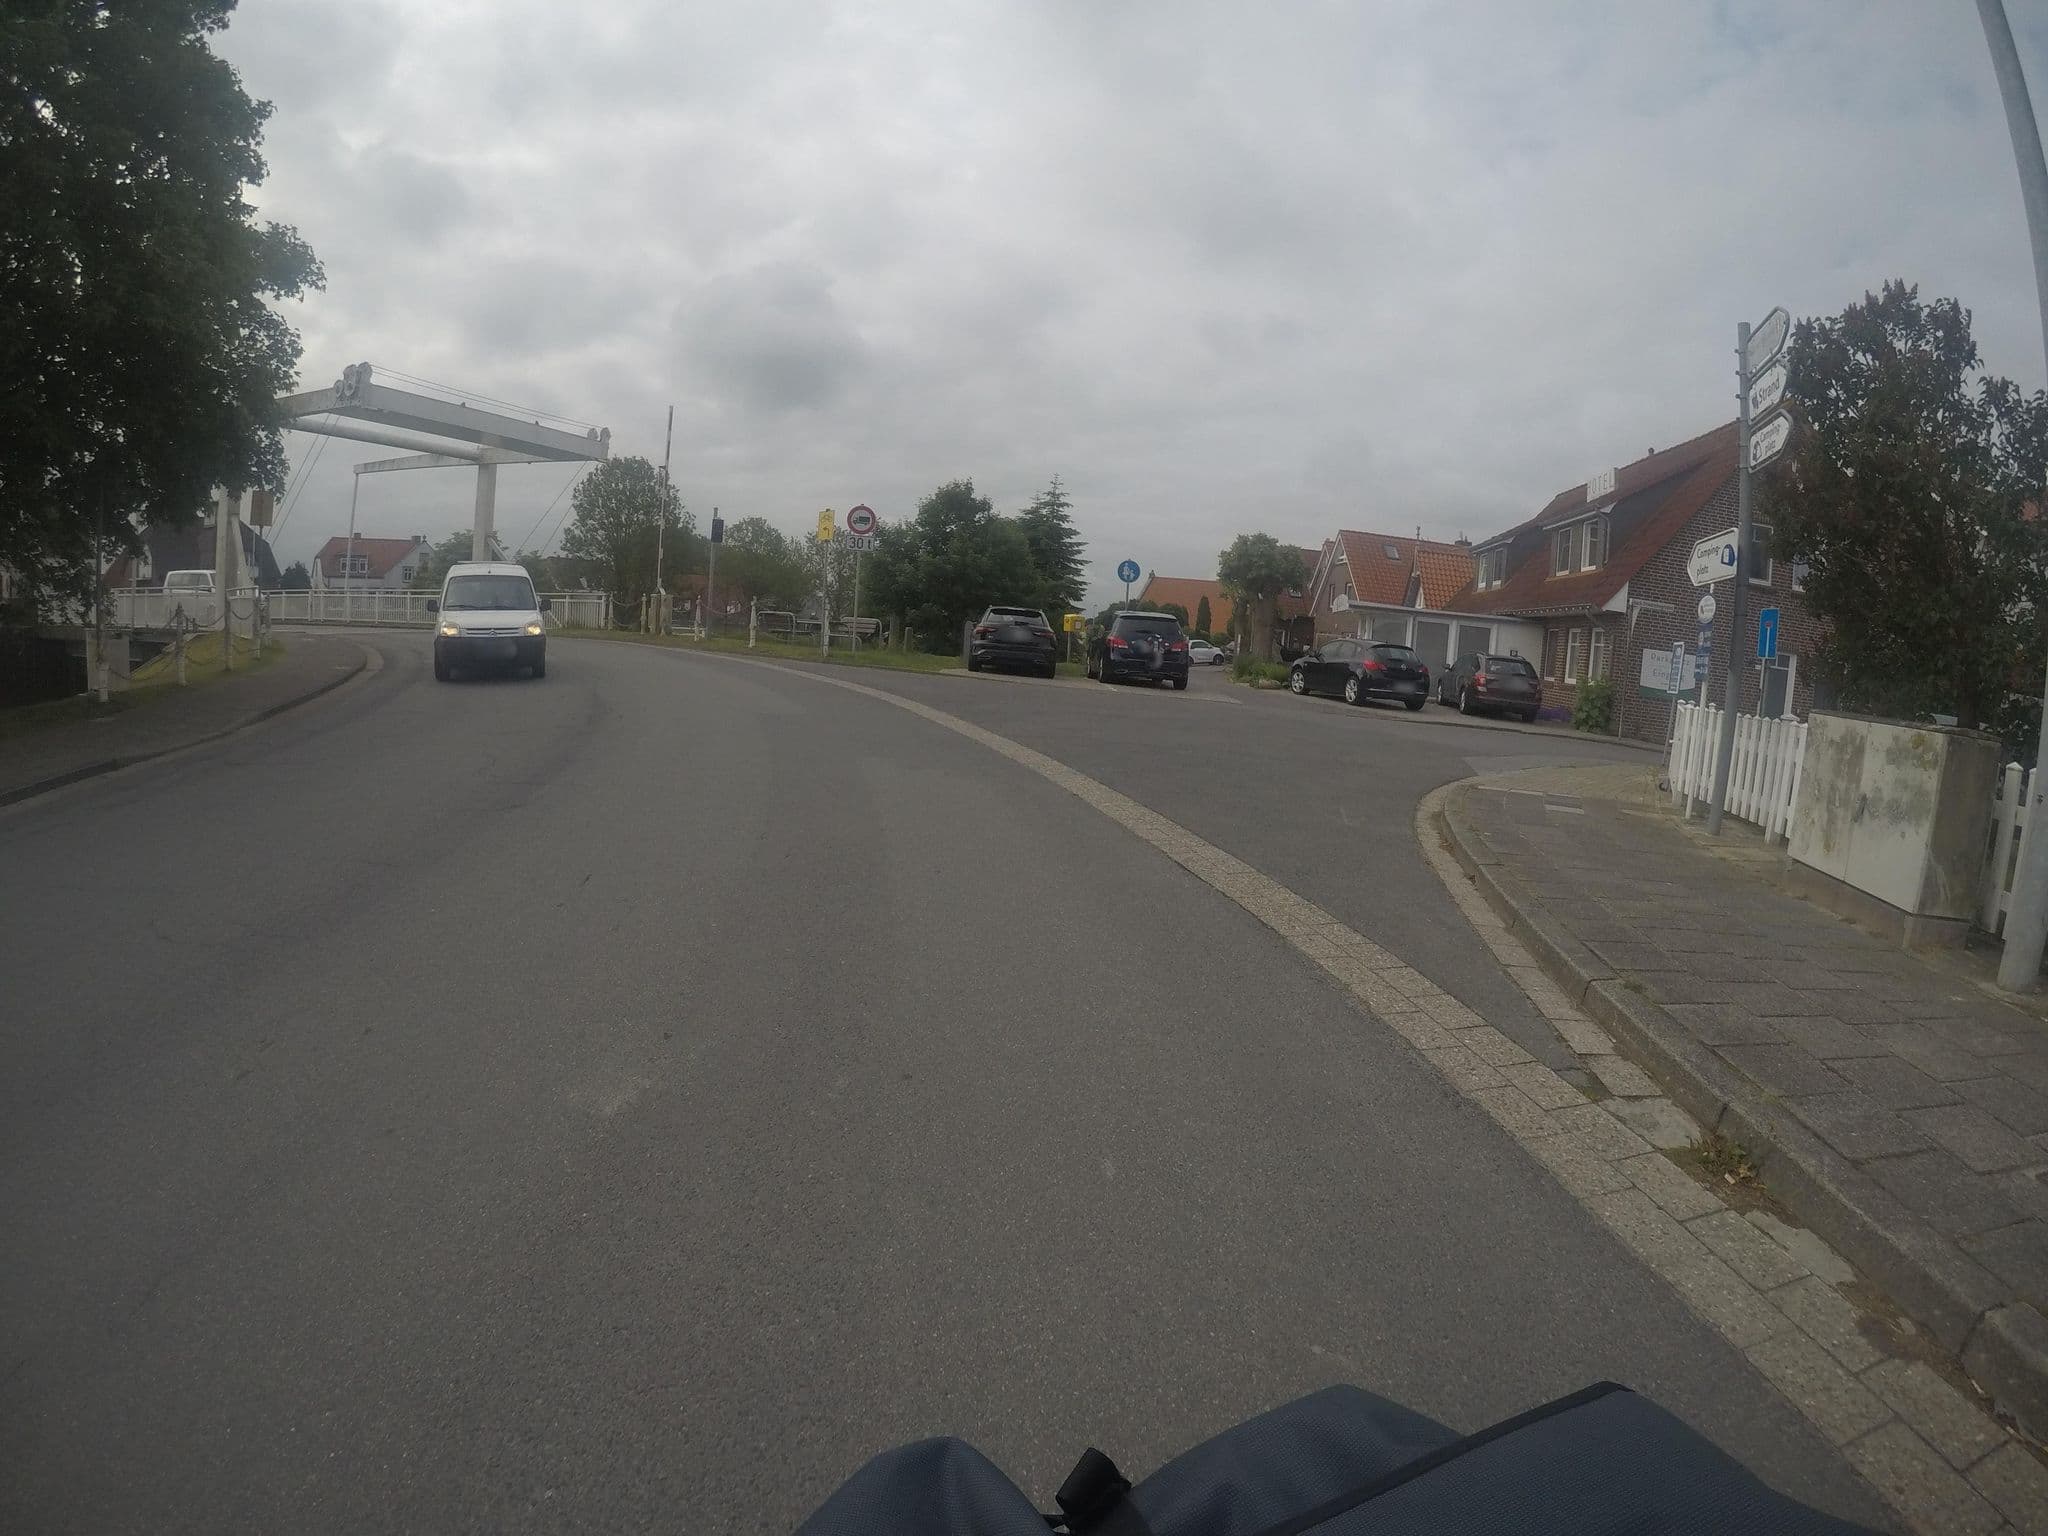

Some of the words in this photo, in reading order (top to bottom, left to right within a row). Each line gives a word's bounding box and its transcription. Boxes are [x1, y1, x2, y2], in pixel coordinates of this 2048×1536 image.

[1758, 375, 1780, 403] Strand
[849, 537, 864, 549] 30
[867, 539, 872, 549] t
